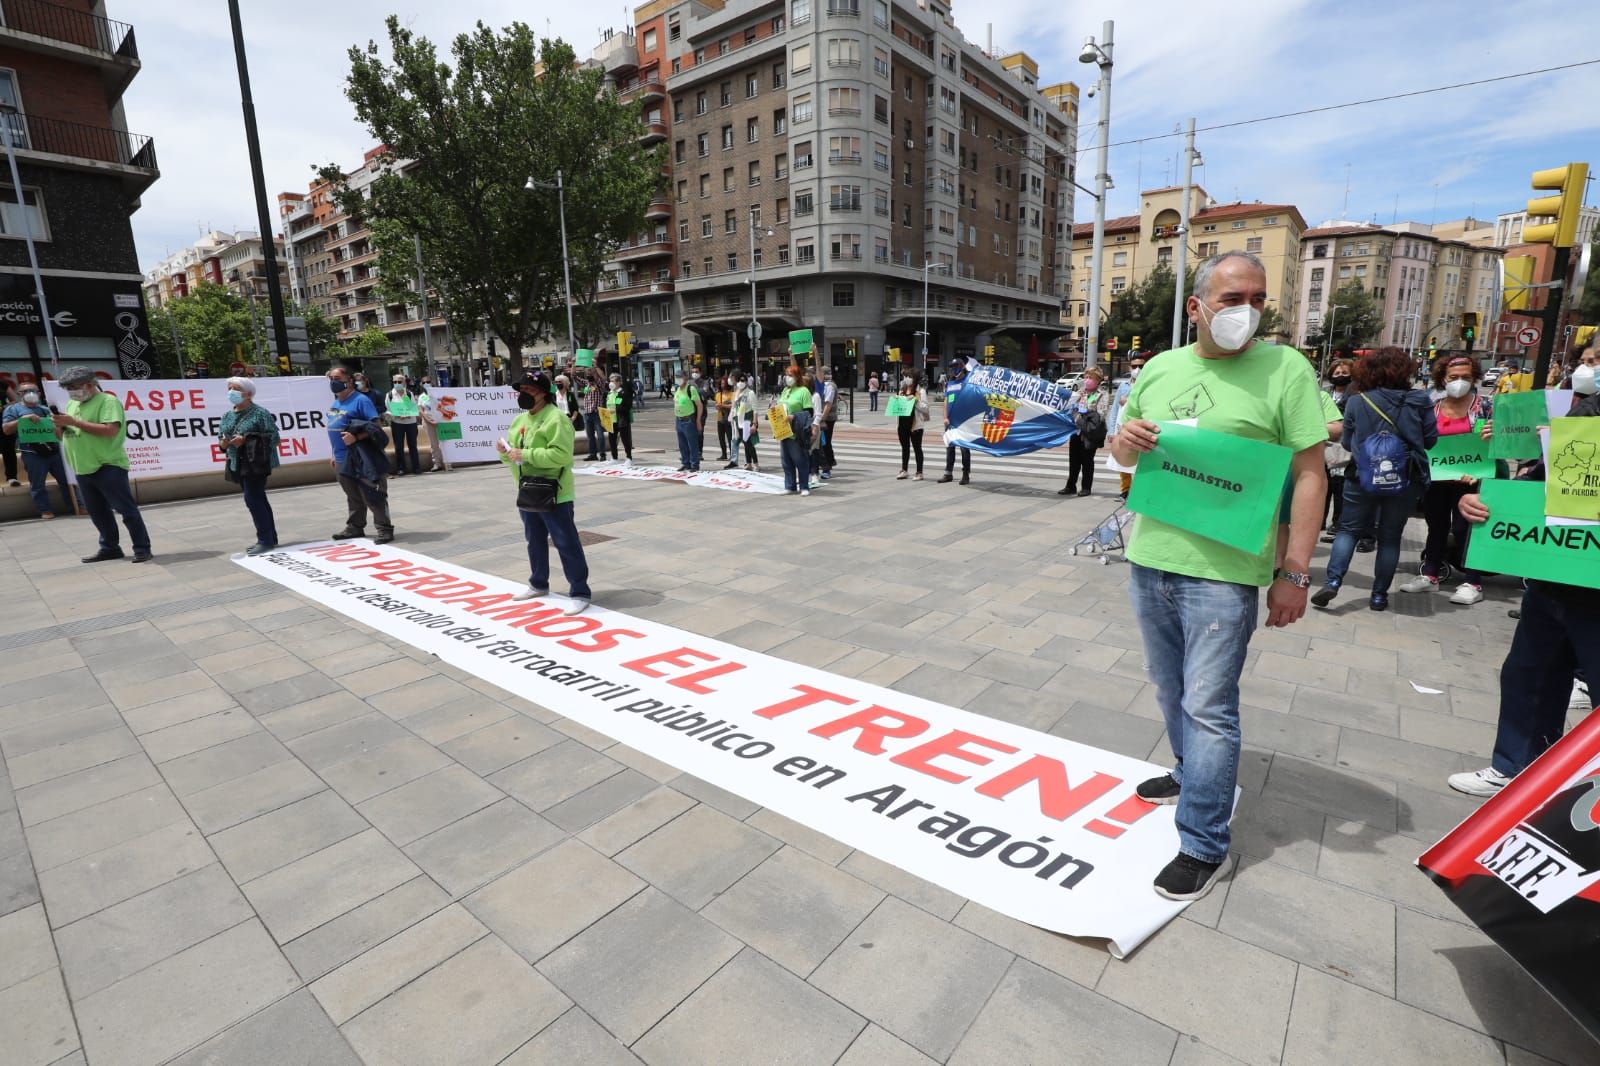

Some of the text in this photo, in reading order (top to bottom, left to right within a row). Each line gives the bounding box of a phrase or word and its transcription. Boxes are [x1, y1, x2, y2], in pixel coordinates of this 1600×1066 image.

[0, 311, 40, 325] rCaja
[465, 391, 521, 401] POR UN TR
[993, 367, 1005, 379] NO
[1009, 370, 1041, 401] PERDER
[1046, 383, 1060, 397] EL
[104, 389, 206, 411] ASPE
[454, 440, 493, 448] SOSTENIBLE
[1431, 453, 1483, 467] FABARA
[1161, 460, 1244, 493] BARBASTRO
[309, 576, 356, 588] por
[340, 586, 377, 595] el
[355, 593, 455, 629] desarrollo
[441, 626, 497, 643] del
[475, 639, 641, 702] ferrocarril
[349, 558, 648, 653] PERDAMOS
[619, 646, 747, 695] EL
[752, 683, 1162, 840] TREN!
[613, 695, 776, 760] público
[771, 748, 848, 790] en
[844, 783, 1096, 891] Aragón
